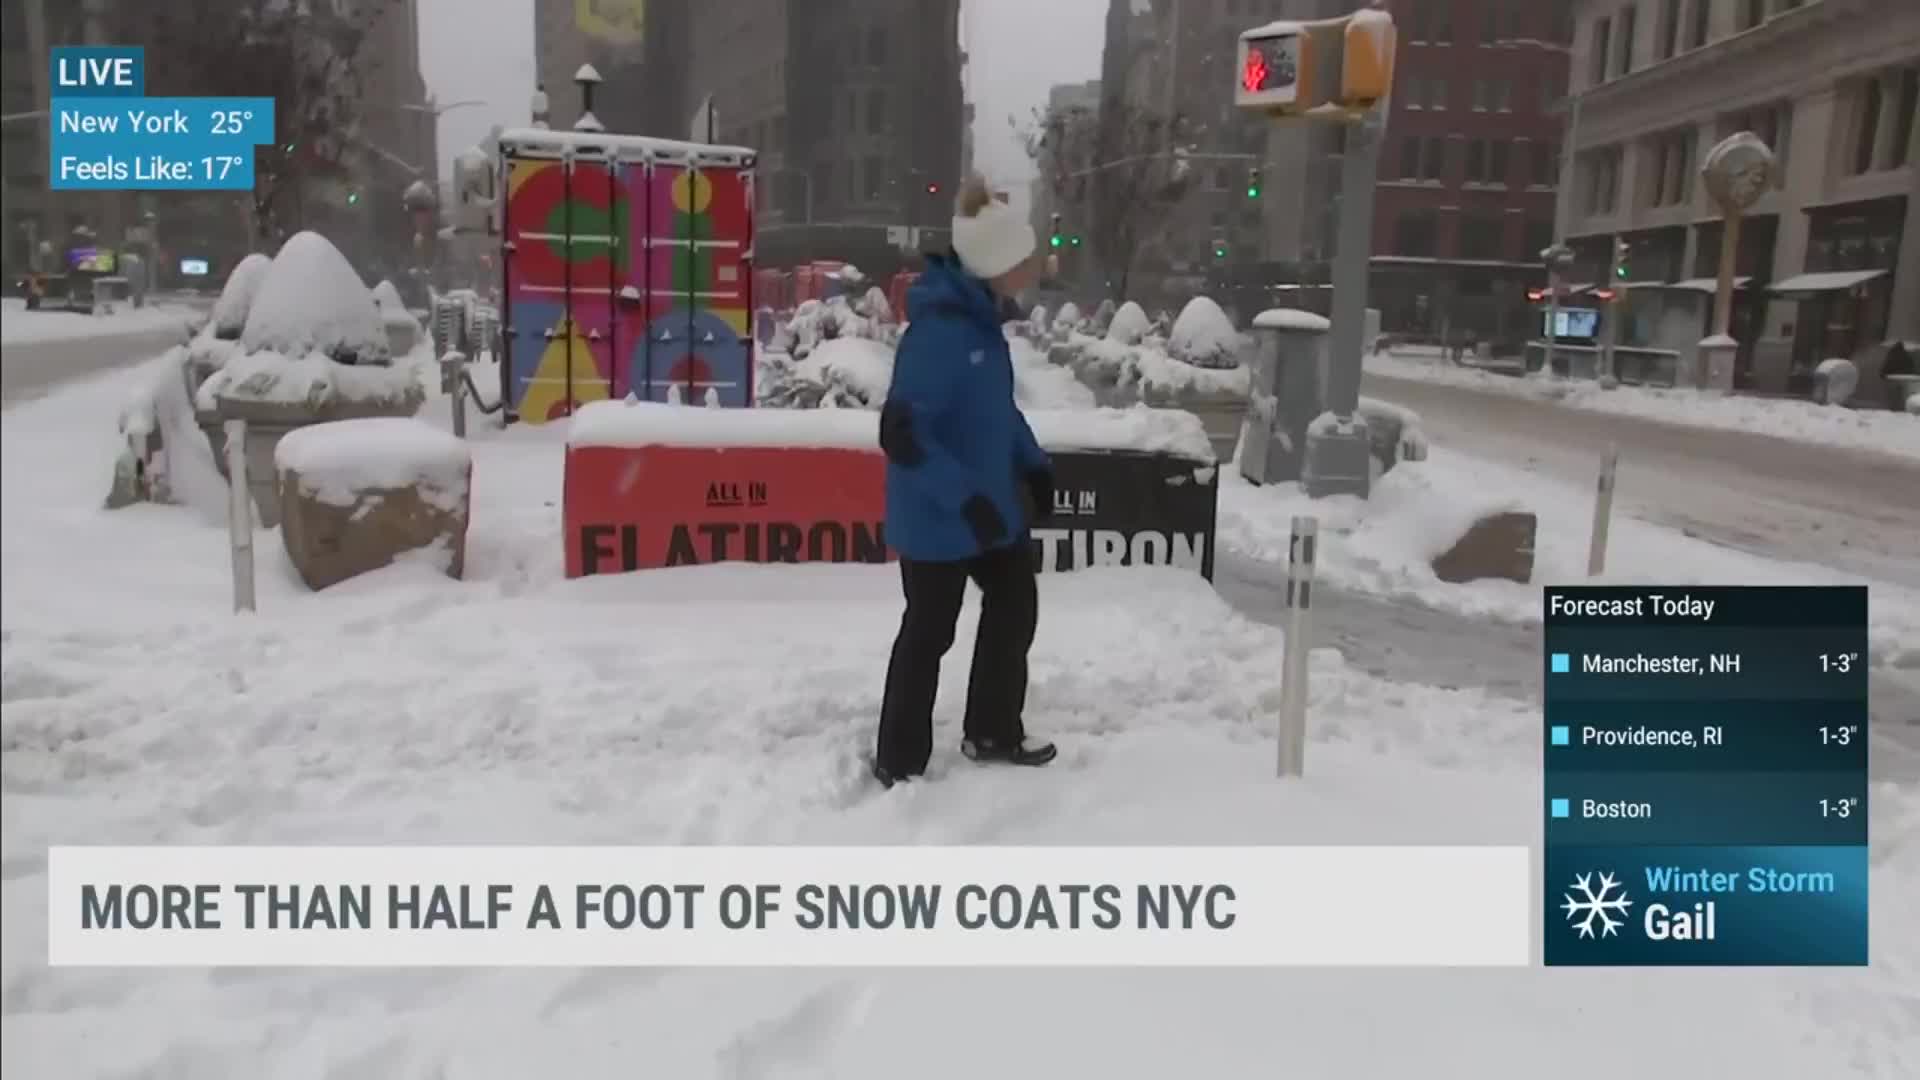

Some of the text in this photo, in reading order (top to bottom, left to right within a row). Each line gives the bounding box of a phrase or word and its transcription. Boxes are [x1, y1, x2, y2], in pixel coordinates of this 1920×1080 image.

[706, 481, 767, 501] ALL IN
[1054, 489, 1096, 509] LL IN
[1029, 528, 1205, 571] TIRON
